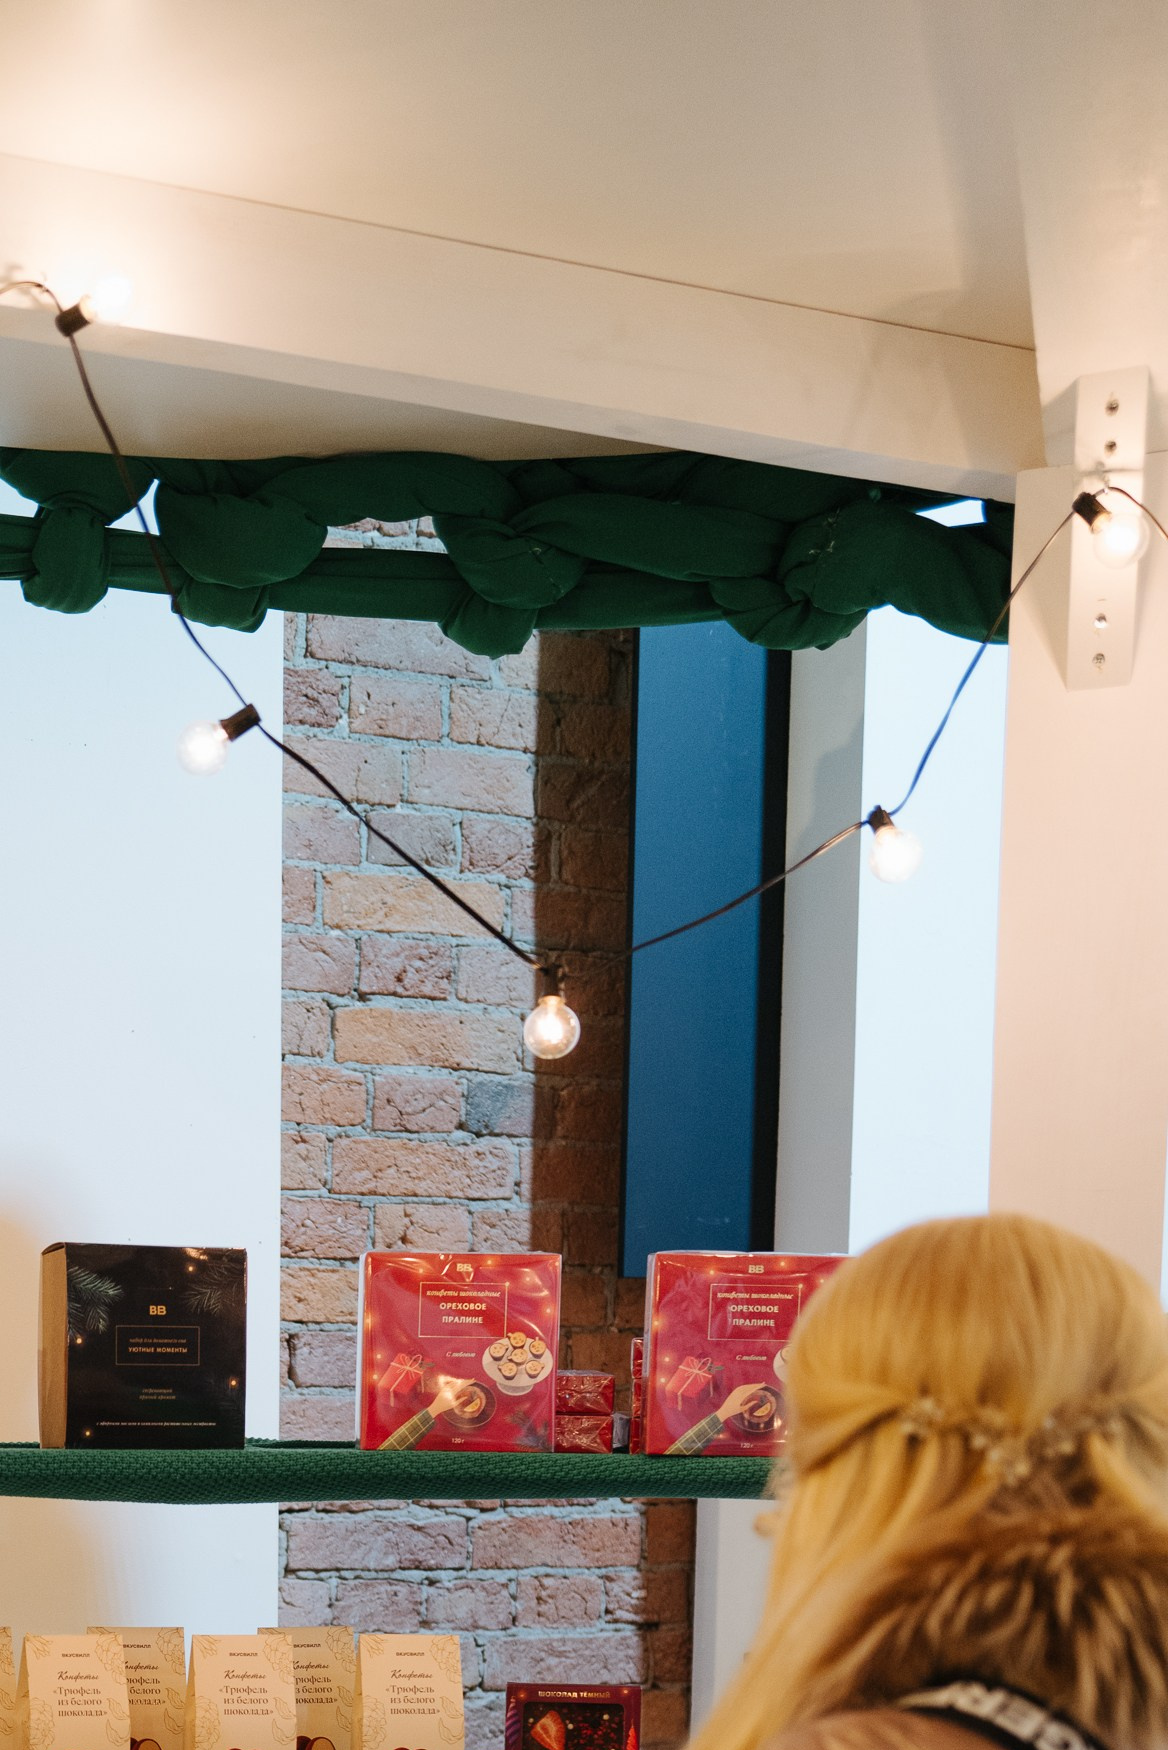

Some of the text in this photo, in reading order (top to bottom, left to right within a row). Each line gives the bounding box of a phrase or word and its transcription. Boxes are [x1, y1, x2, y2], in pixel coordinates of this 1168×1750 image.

[426, 1289, 500, 1298] конфеты шоколадные
[750, 1292, 794, 1300] шоколадные
[439, 1302, 487, 1310] ОРЕХОВОЕ
[730, 1304, 779, 1312] ОРЕХОВОЕ
[442, 1316, 483, 1324] ПРАЛИНЕ
[732, 1318, 775, 1326] ПРАЛИНЕ
[125, 1661, 160, 1672] онфеты
[56, 1670, 100, 1681] Конфеты
[224, 1670, 268, 1681] Конфеты
[390, 1669, 433, 1680] Конфеты
[294, 1674, 332, 1686] рюфель
[52, 1686, 101, 1697] «Трюфель
[129, 1686, 160, 1695] белого
[218, 1685, 268, 1696] «Трюфель
[302, 1685, 332, 1694] белого
[386, 1684, 435, 1696] «Трюфель
[538, 1690, 610, 1698] ШОКОЛАД ТЁМНЫЙ
[70, 1697, 102, 1706] белого
[236, 1696, 269, 1704] белого
[403, 1694, 436, 1704] белого
[58, 1709, 108, 1717] шоколада»
[224, 1708, 274, 1716] шоколада»
